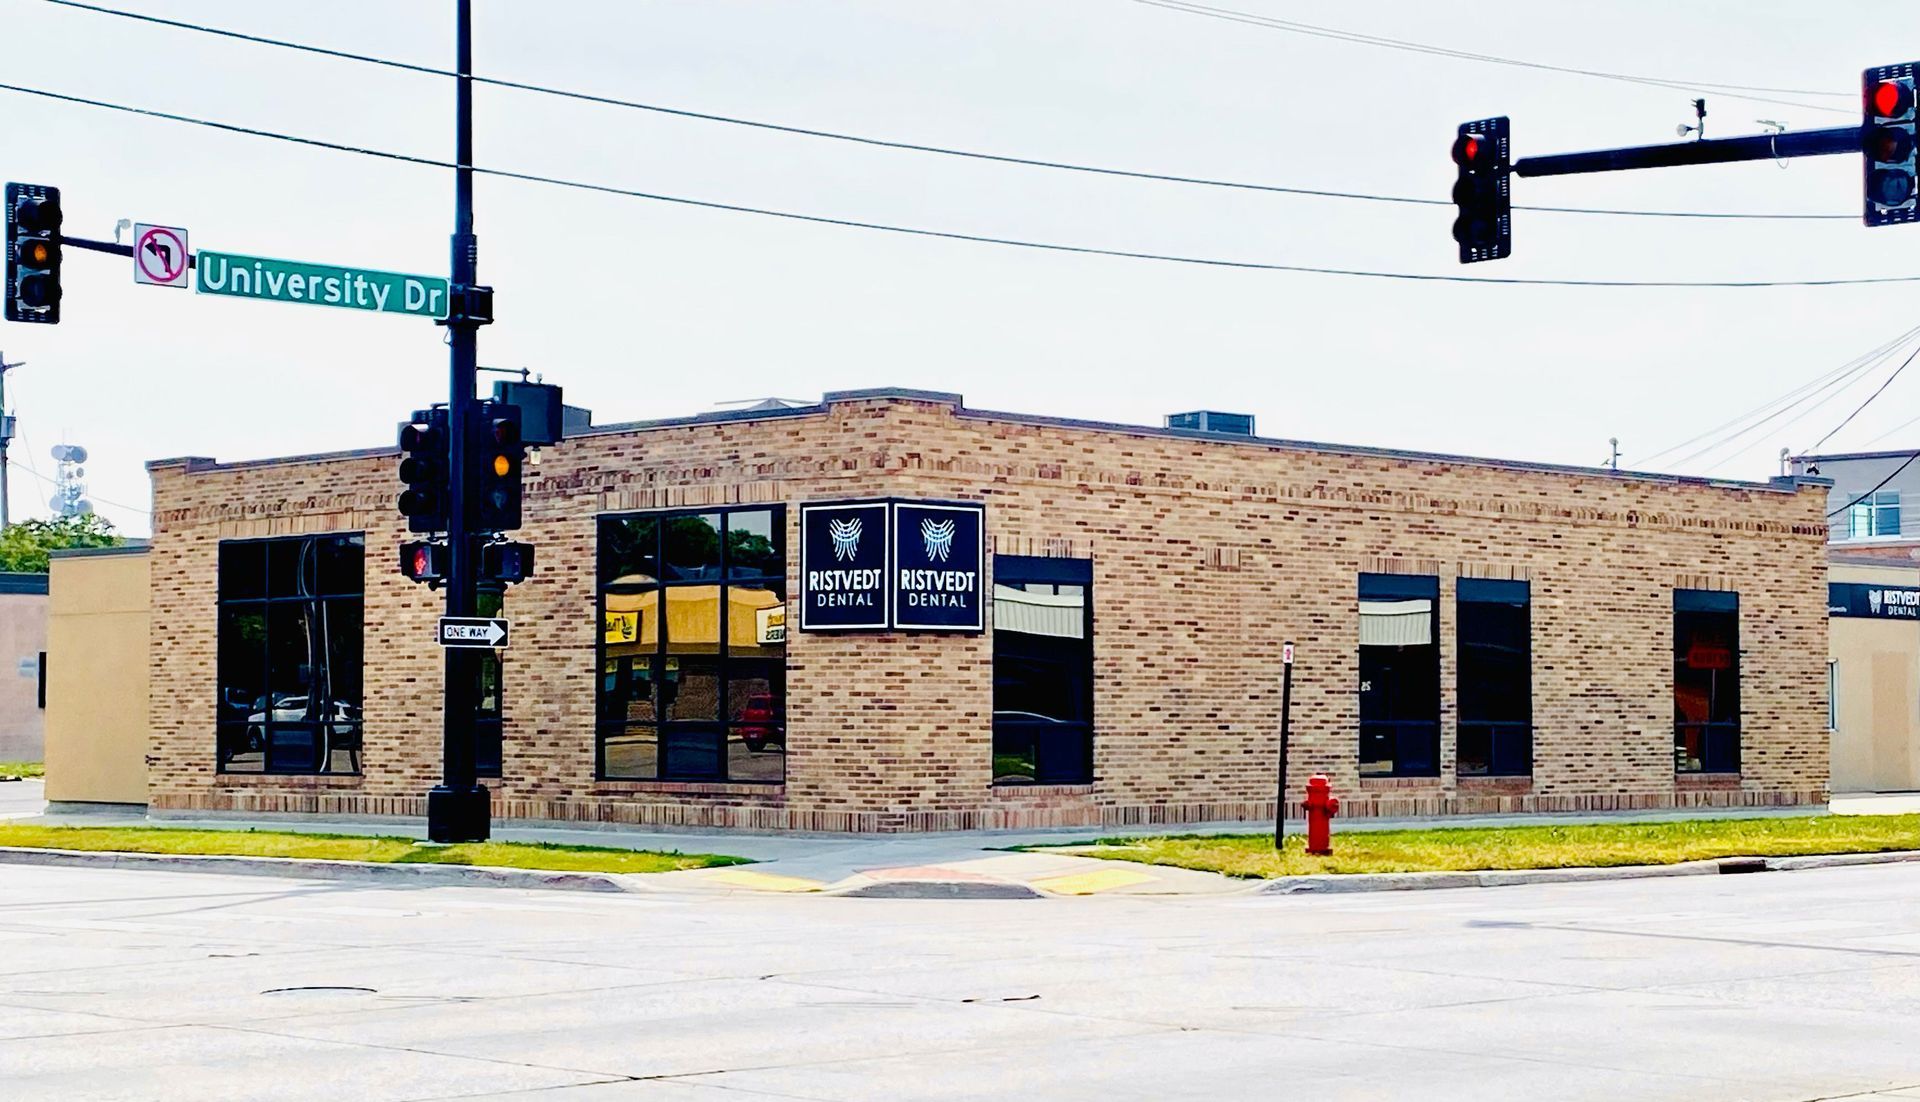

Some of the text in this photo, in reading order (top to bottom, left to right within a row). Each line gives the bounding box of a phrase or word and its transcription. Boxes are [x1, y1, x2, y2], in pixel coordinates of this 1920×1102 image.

[203, 256, 443, 313] University Dr
[809, 569, 882, 591] RISTVEDT
[901, 569, 976, 592] RISTVEDT
[817, 593, 873, 607] DENTAL
[909, 593, 967, 608] DENTAL
[1887, 605, 1917, 617] DENTAL
[446, 627, 488, 637] ONE WAY
